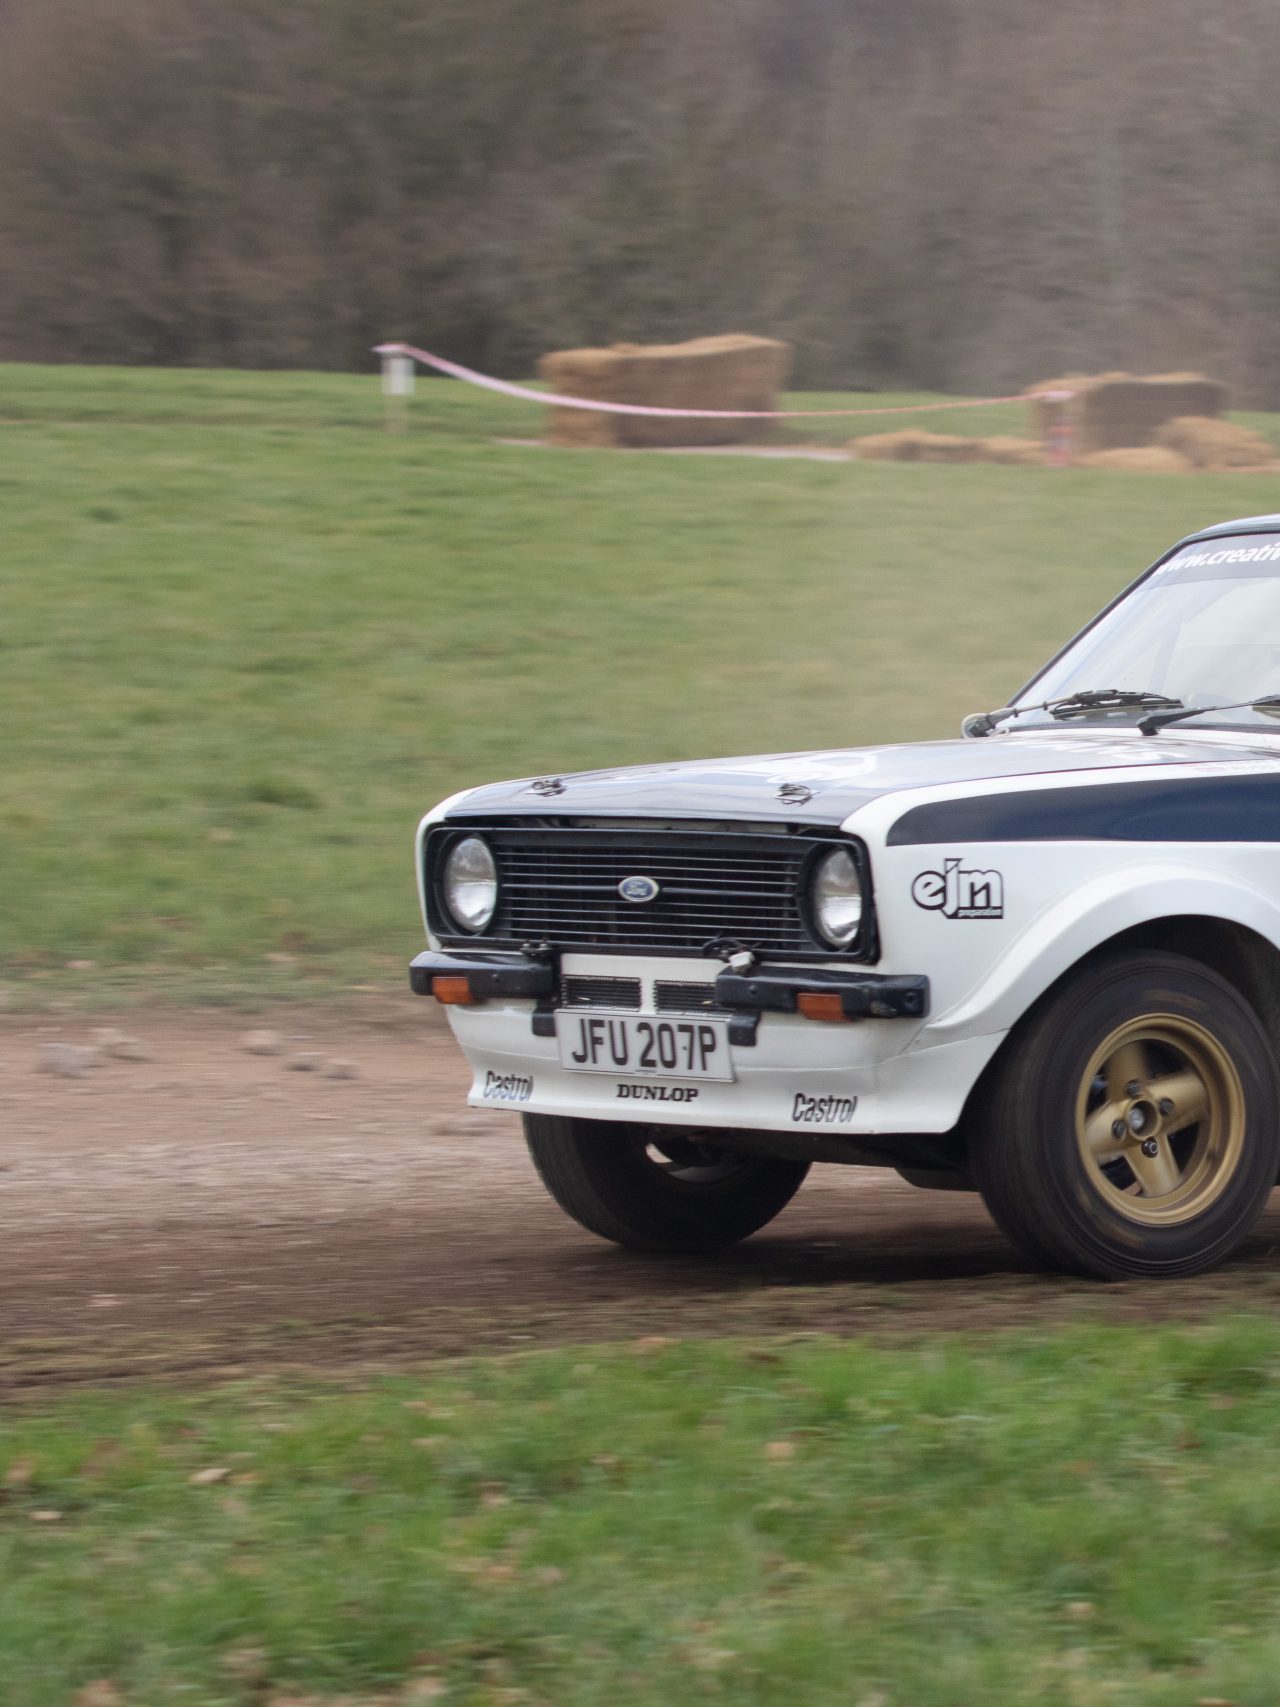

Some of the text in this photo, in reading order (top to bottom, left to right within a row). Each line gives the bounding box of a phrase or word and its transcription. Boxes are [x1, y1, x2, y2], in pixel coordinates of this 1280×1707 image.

[911, 857, 1004, 918] ejm
[571, 1018, 717, 1071] JFU 207P
[483, 1070, 534, 1101] Castrol
[616, 1083, 699, 1103] DUNLOP
[792, 1092, 859, 1123] Castrol
